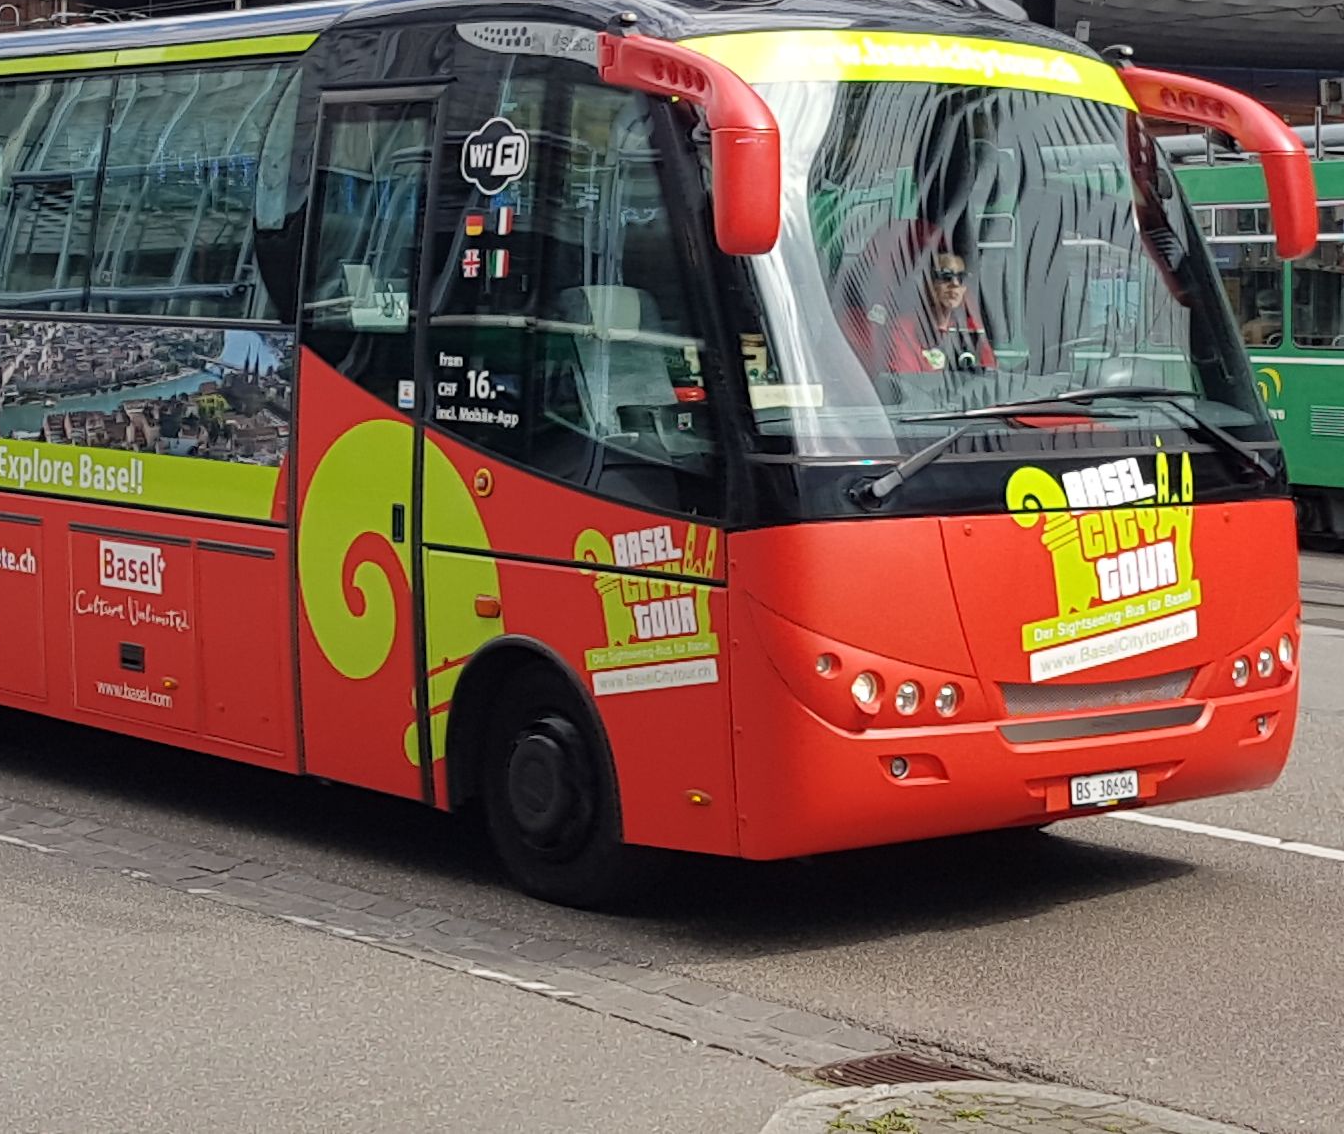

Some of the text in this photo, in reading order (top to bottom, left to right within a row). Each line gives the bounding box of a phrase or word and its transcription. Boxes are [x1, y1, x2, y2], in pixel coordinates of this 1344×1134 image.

[79, 454, 143, 495] Basel!
[1062, 457, 1157, 515] BASEL
[612, 525, 683, 566] BASEL
[1078, 498, 1158, 559] CITY
[103, 548, 157, 587] Basel
[1096, 540, 1177, 602] TOUR
[75, 589, 191, 633] Culture Unlimited
[633, 596, 697, 639] TOUR
[1034, 627, 1054, 642] Der
[1165, 590, 1193, 608] Basel
[97, 681, 173, 708] www.basel.com
